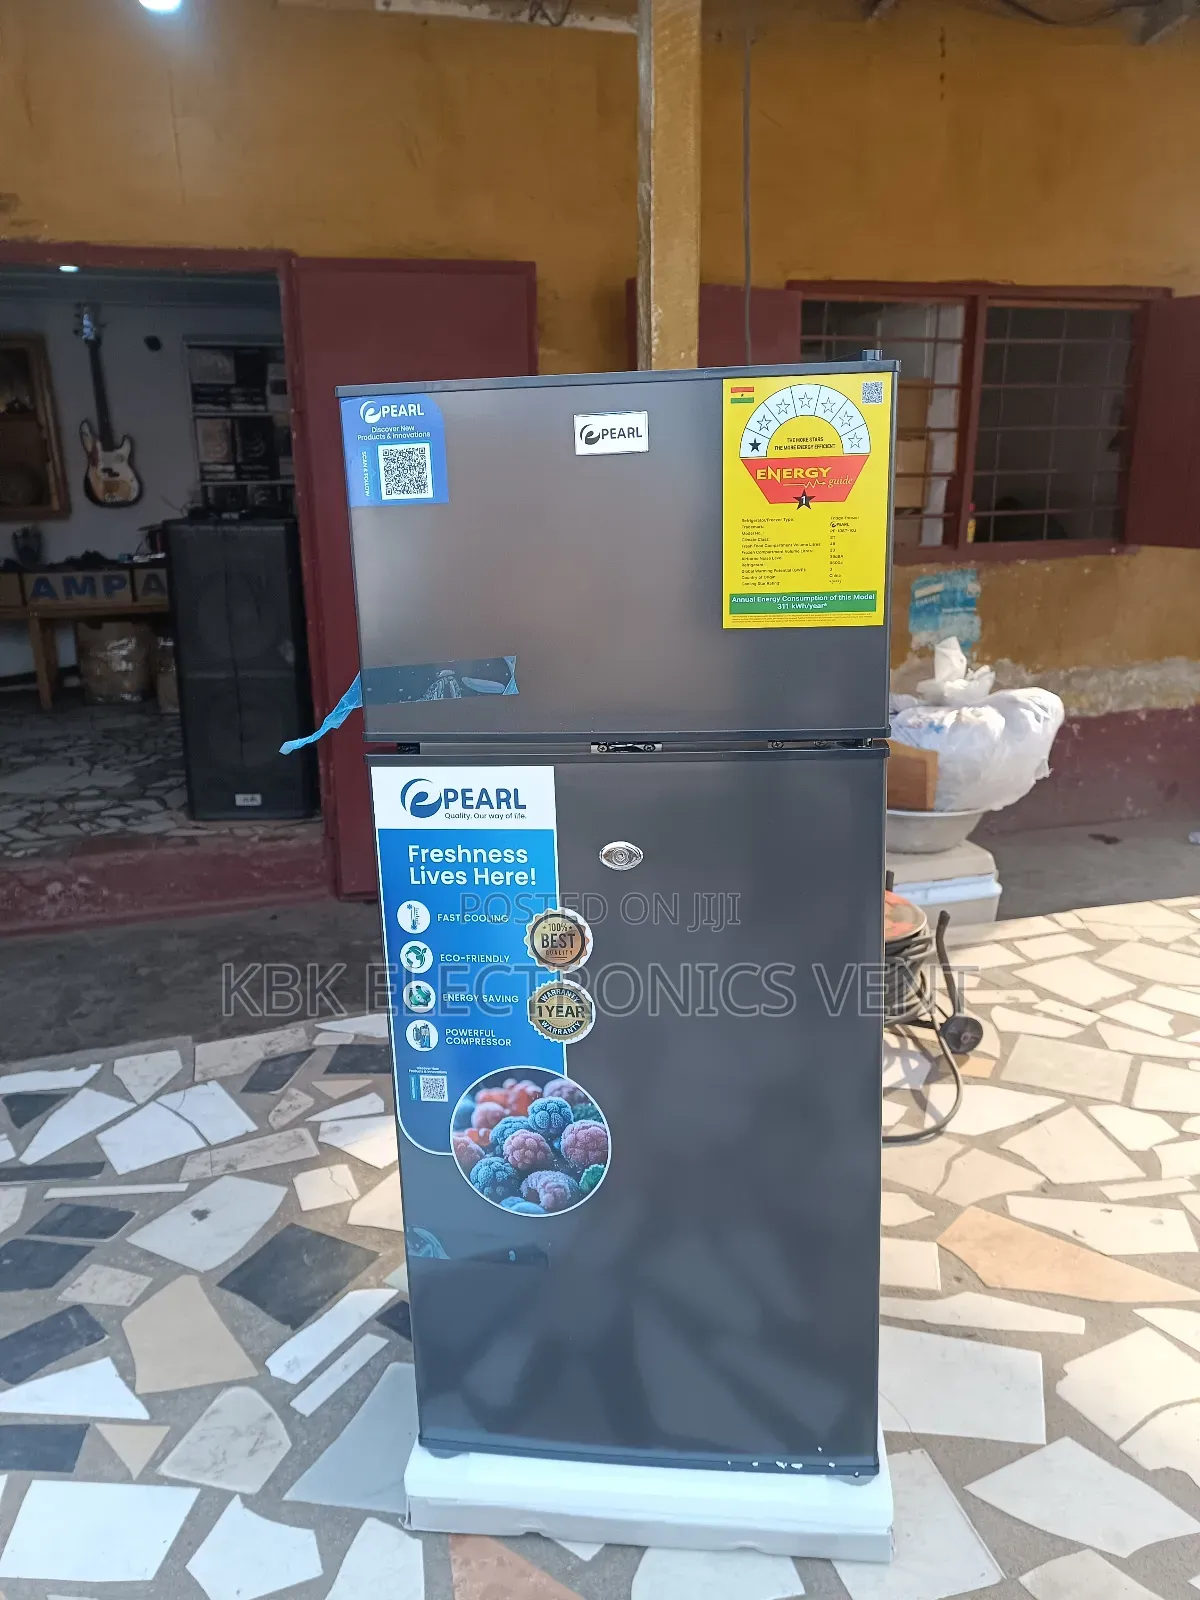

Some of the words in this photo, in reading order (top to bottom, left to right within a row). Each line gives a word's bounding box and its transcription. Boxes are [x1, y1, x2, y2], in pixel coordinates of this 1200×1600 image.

[371, 426, 400, 434] Discover
[392, 430, 431, 439] Innovations
[756, 465, 832, 484] ENERGY
[827, 474, 854, 489] guide
[801, 496, 806, 505] 1
[782, 594, 828, 602] Consumption
[444, 812, 473, 820] Quality.
[408, 844, 528, 864] Freshness
[409, 866, 468, 885] Lives
[473, 867, 536, 886] Here!
[437, 913, 460, 922] FAST
[464, 914, 509, 923] COOLING
[548, 922, 568, 932] 100%
[541, 933, 576, 949] BEST
[440, 953, 510, 963] ECO-FRIENDLY
[442, 993, 480, 1002] ENERGY
[482, 994, 519, 1003] SAVING
[540, 988, 581, 1003] WARRANTY
[445, 1028, 496, 1038] POWERFUL
[541, 1020, 581, 1036] WARRANTY
[445, 1037, 512, 1047] COMPRESSOR
